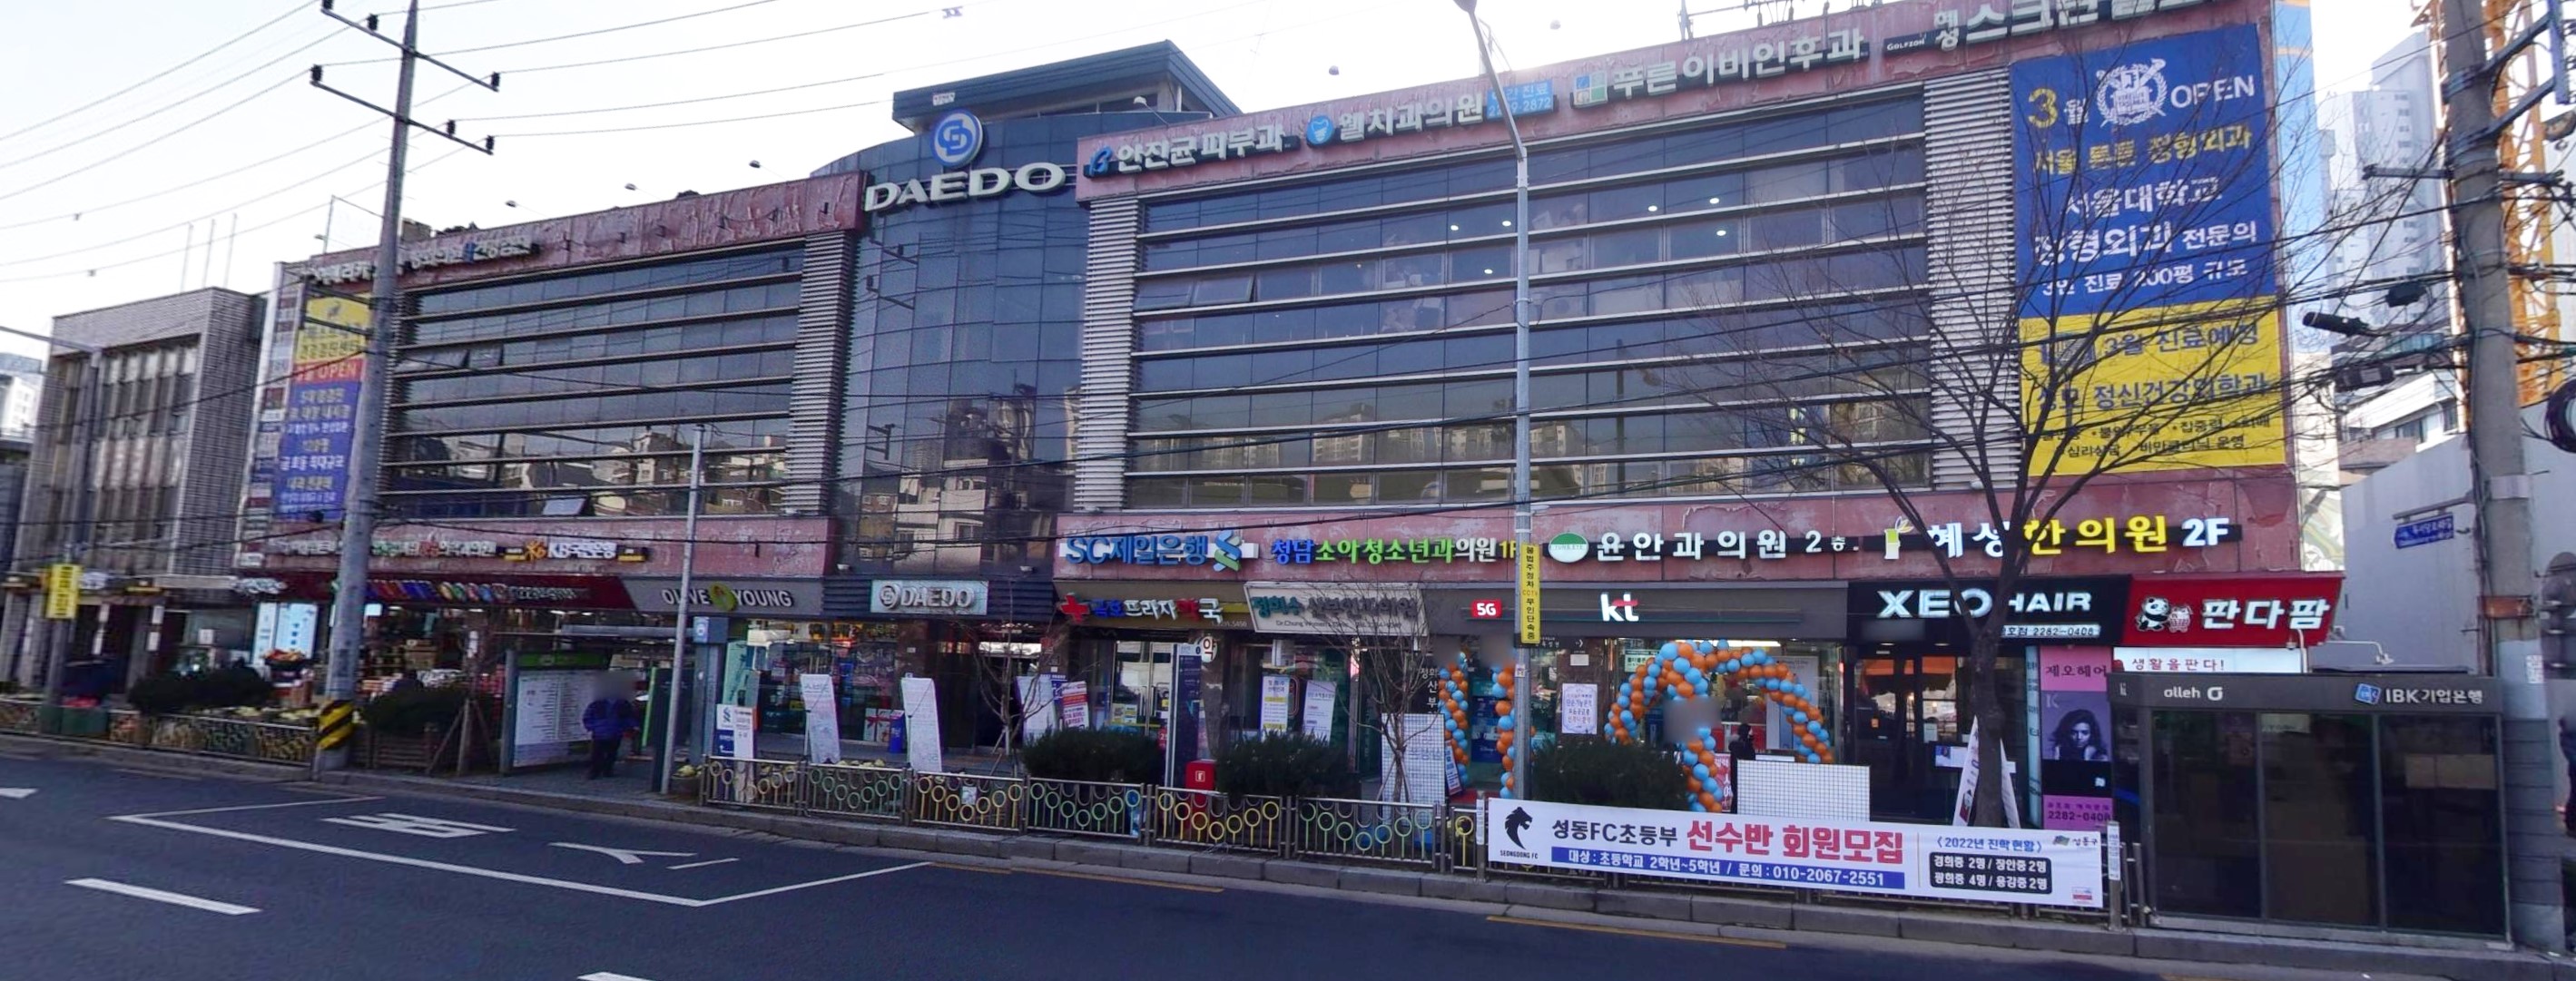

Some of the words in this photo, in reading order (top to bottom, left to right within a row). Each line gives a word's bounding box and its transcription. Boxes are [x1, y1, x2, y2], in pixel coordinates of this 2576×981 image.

[1886, 37, 1925, 51] GOLFZON
[2170, 74, 2255, 110] OPEN
[1339, 92, 1483, 142] 웰치과의원
[2034, 149, 2078, 175] 서울
[2148, 124, 2253, 164] 정형외과
[864, 162, 1066, 211] DAEDO
[2060, 176, 2224, 219] 서울대학교
[2034, 221, 2173, 266] 정형외과
[2182, 221, 2257, 250] 전문의
[2084, 273, 2123, 293] 진료
[2134, 263, 2194, 288] 200평
[2203, 260, 2249, 280] 규모
[2104, 332, 2145, 356] 3월
[319, 360, 357, 379] OPEN
[1597, 529, 1786, 561] 윤안과의원
[2183, 517, 2230, 546] 2F
[1066, 535, 1209, 565] SC제일은행
[661, 588, 711, 605] OLVE
[731, 590, 793, 607] YOUNG
[900, 587, 976, 609] DAEDO
[1476, 602, 1498, 617] 5G
[1600, 592, 1640, 623] kt
[1877, 588, 1992, 618] XEO
[2202, 599, 2331, 630] 판다팜
[2164, 686, 2200, 699] olleh
[2385, 689, 2483, 703] IBK기업은행
[1499, 849, 1530, 858] SEONGDONG
[1531, 851, 1539, 859] FC
[1551, 819, 1678, 848] 성동FC초등부
[1686, 819, 1774, 857] 선수반
[1783, 824, 1903, 865] 회원모집
[1649, 855, 1721, 875] 2학년~5학년
[1773, 867, 1884, 887] 010-2067-2551
[1969, 857, 1985, 869] 2명
[2030, 859, 2047, 873] 2명
[1971, 873, 1986, 887] 4명
[2030, 877, 2048, 890] 2명
